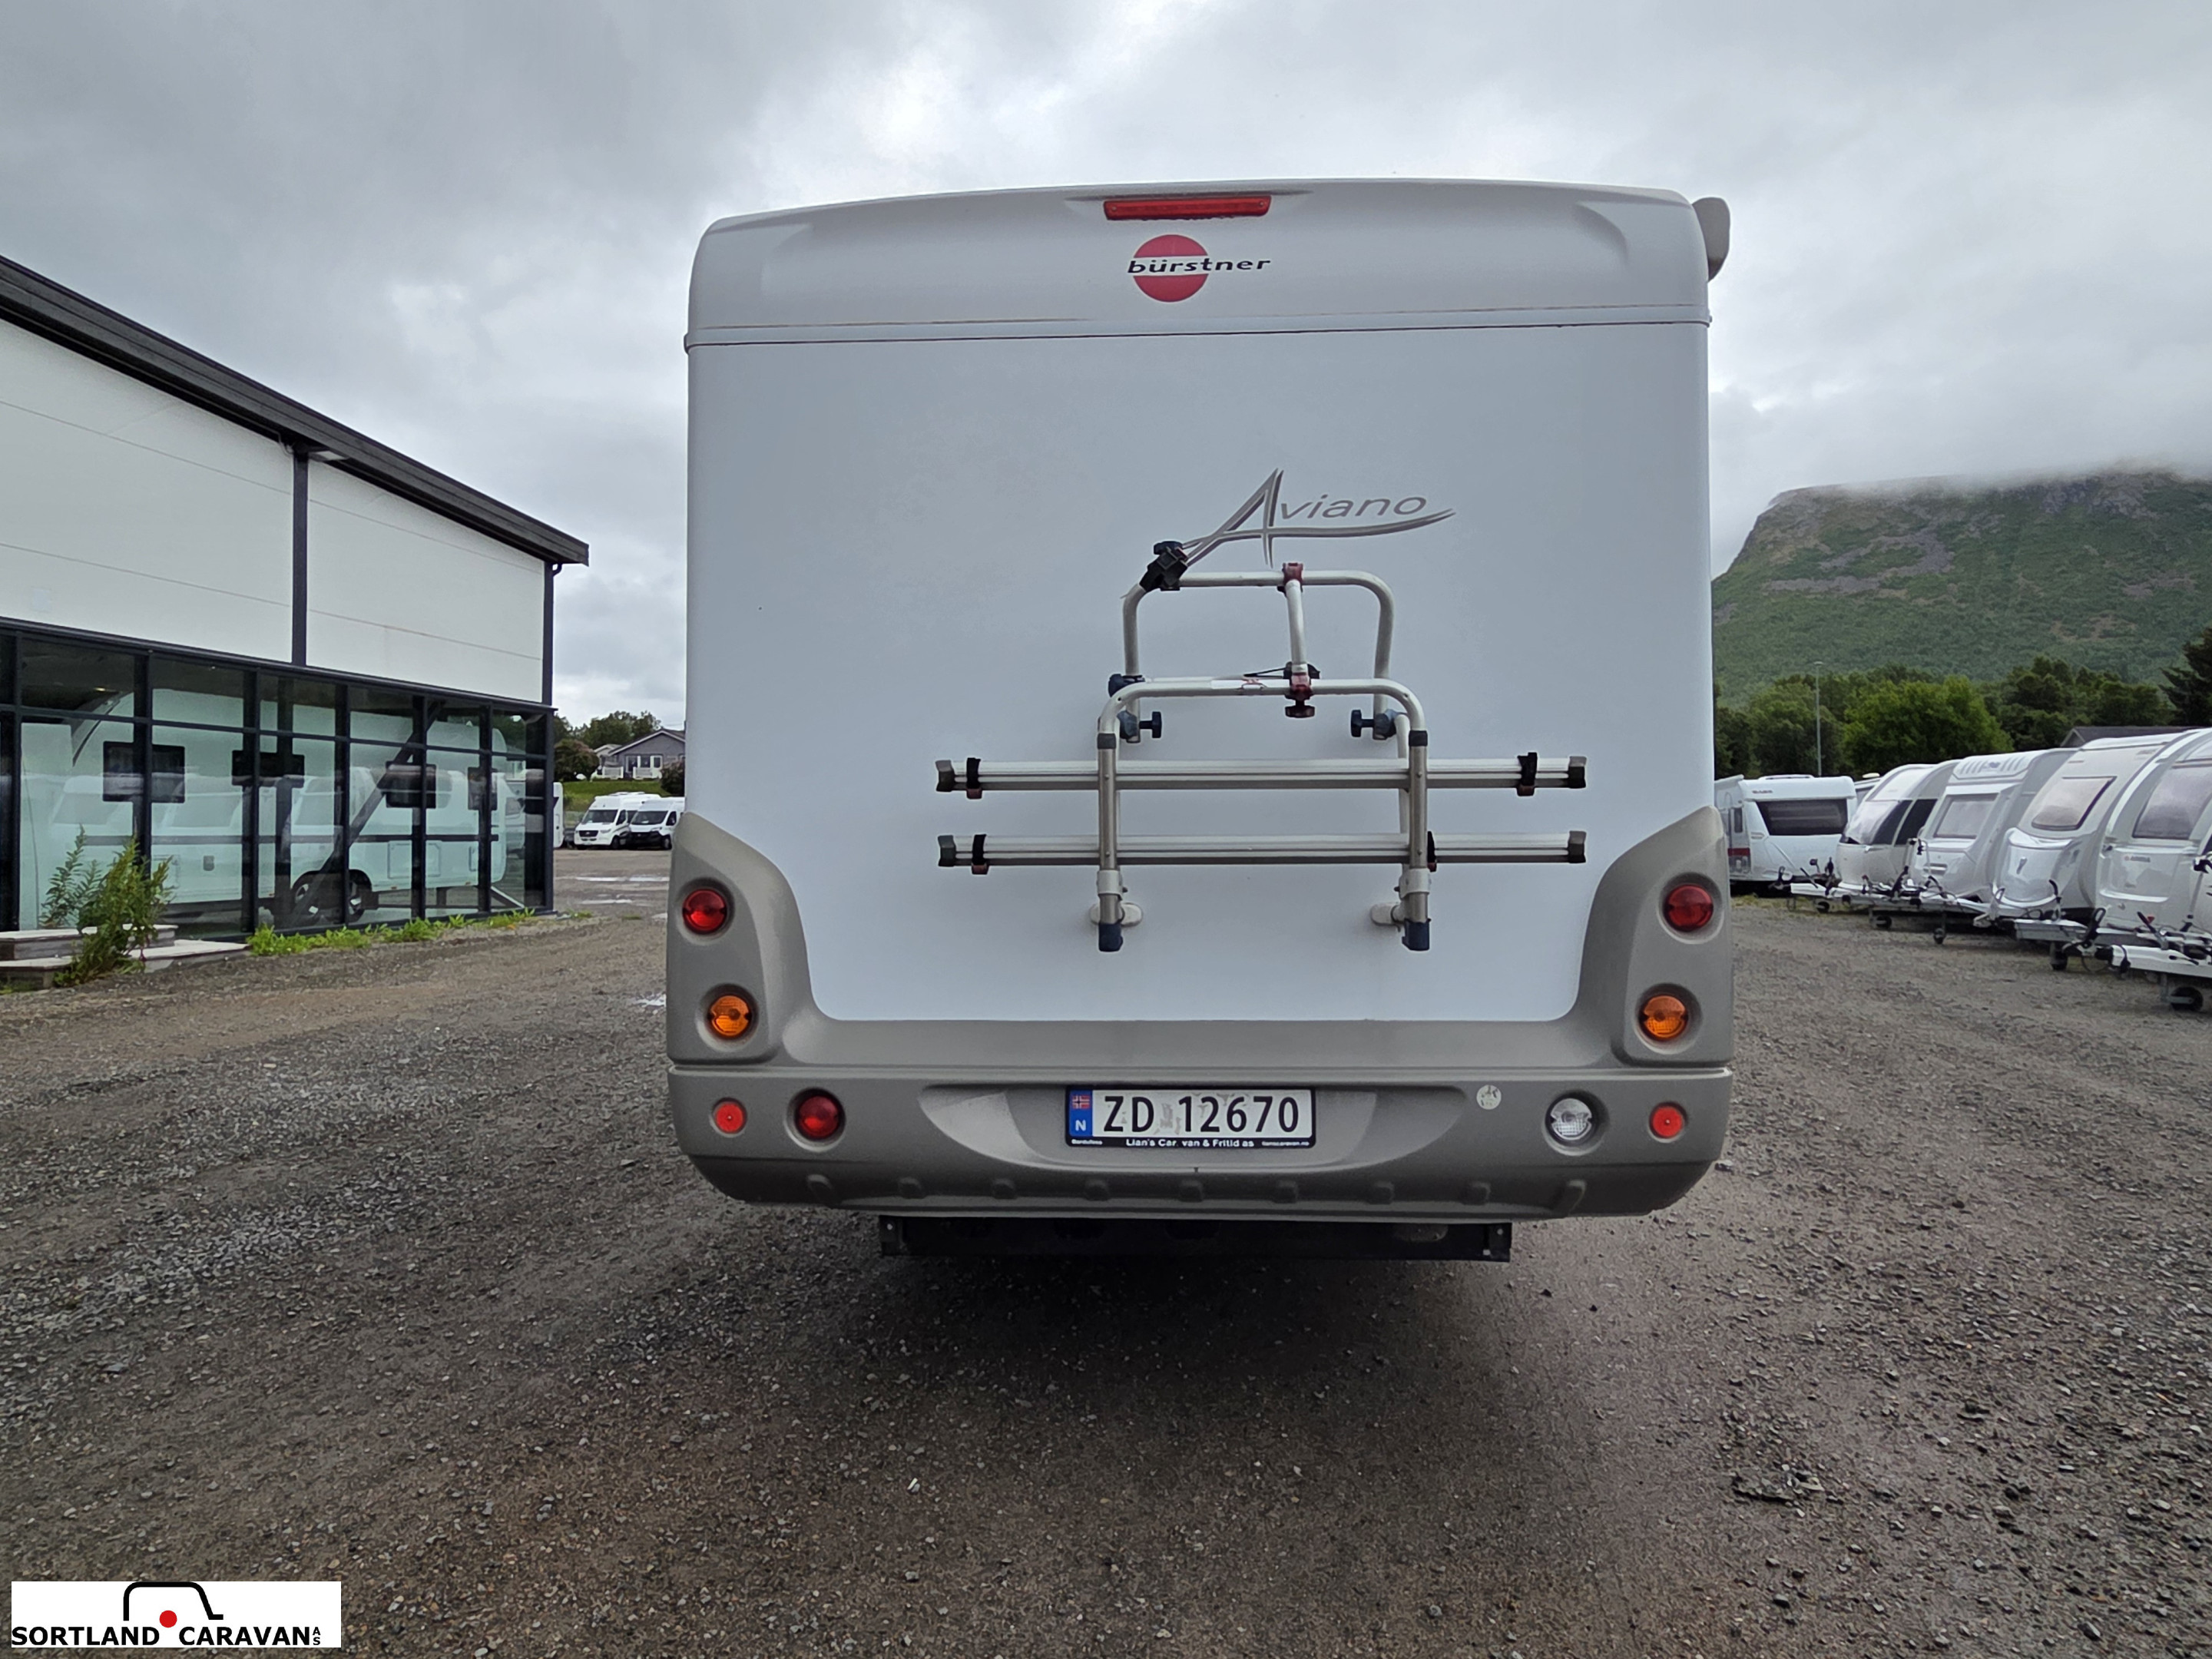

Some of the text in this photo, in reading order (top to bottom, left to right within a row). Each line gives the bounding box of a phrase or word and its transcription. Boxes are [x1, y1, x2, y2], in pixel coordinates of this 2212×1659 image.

[1127, 258, 1271, 273] bürstner
[1184, 468, 1455, 568] Aviano
[1075, 1120, 1087, 1131] N
[1104, 1096, 1299, 1133] ZD 12670
